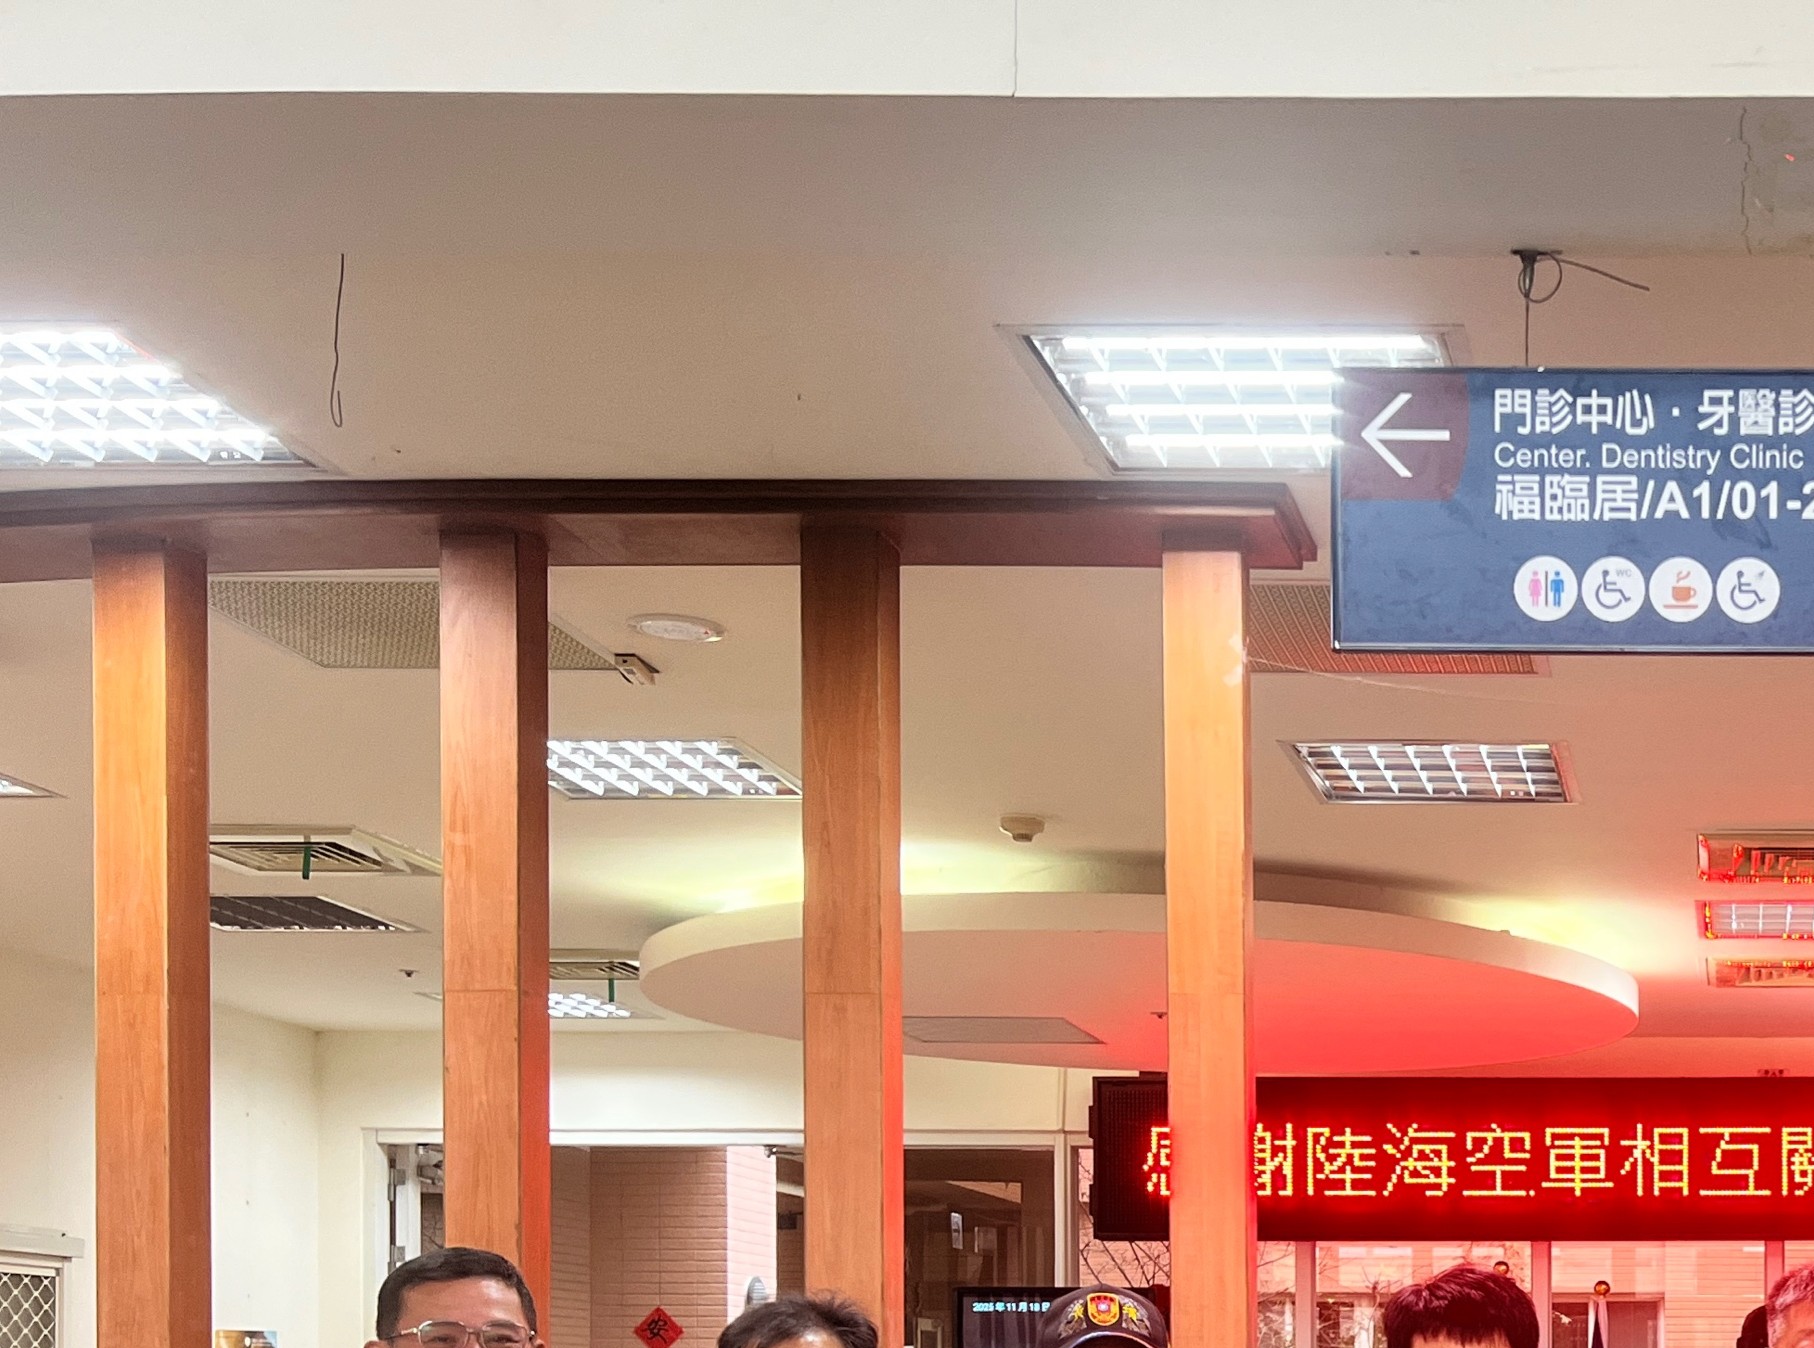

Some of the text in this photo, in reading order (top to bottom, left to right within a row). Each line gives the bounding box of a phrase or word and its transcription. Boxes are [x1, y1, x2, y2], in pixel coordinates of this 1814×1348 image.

[1494, 442, 1804, 475] Center. Dentistry Clinic
[641, 1316, 669, 1344] 安
